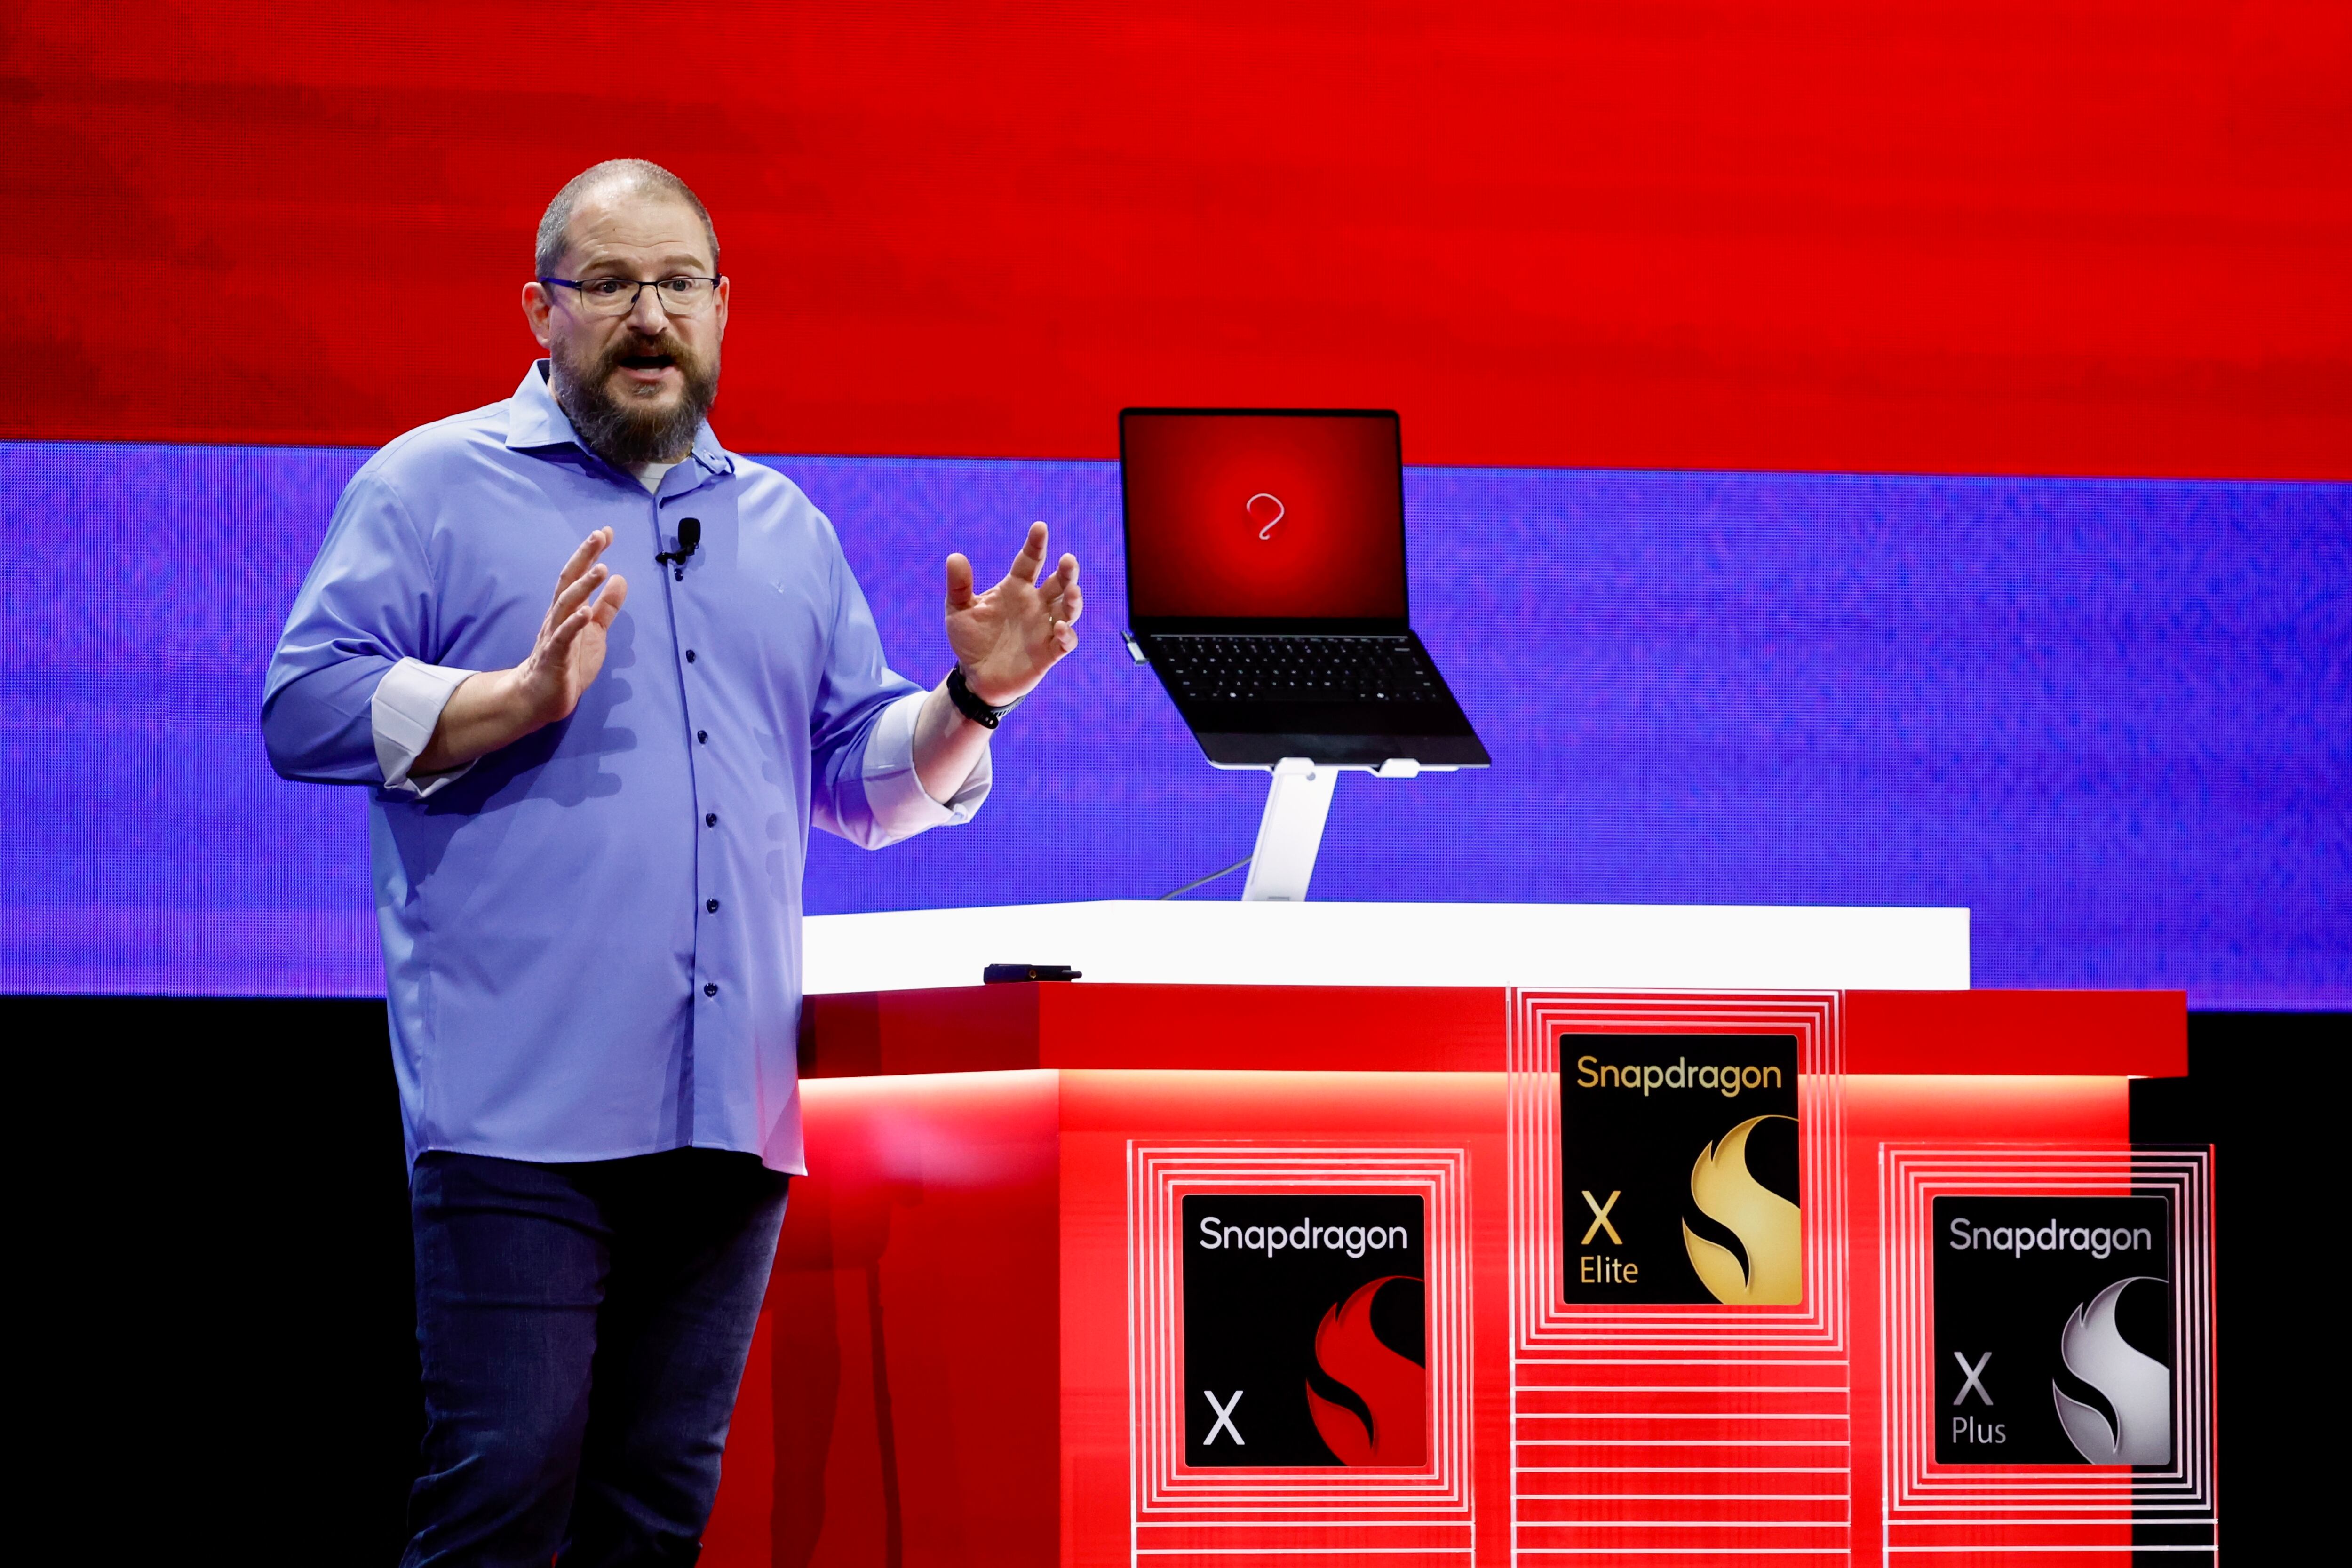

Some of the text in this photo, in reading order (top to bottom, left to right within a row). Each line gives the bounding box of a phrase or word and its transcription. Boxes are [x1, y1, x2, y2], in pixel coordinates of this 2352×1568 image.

[1577, 1055, 1781, 1098] Snapdragon
[1200, 1216, 1407, 1258] Snapdragon
[1581, 1190, 1623, 1245] X
[1950, 1218, 2151, 1259] Snapdragon
[1581, 1255, 1638, 1283] Elite
[1953, 1351, 1994, 1405] X
[1203, 1390, 1245, 1445] X
[1953, 1416, 2006, 1444] Plus
